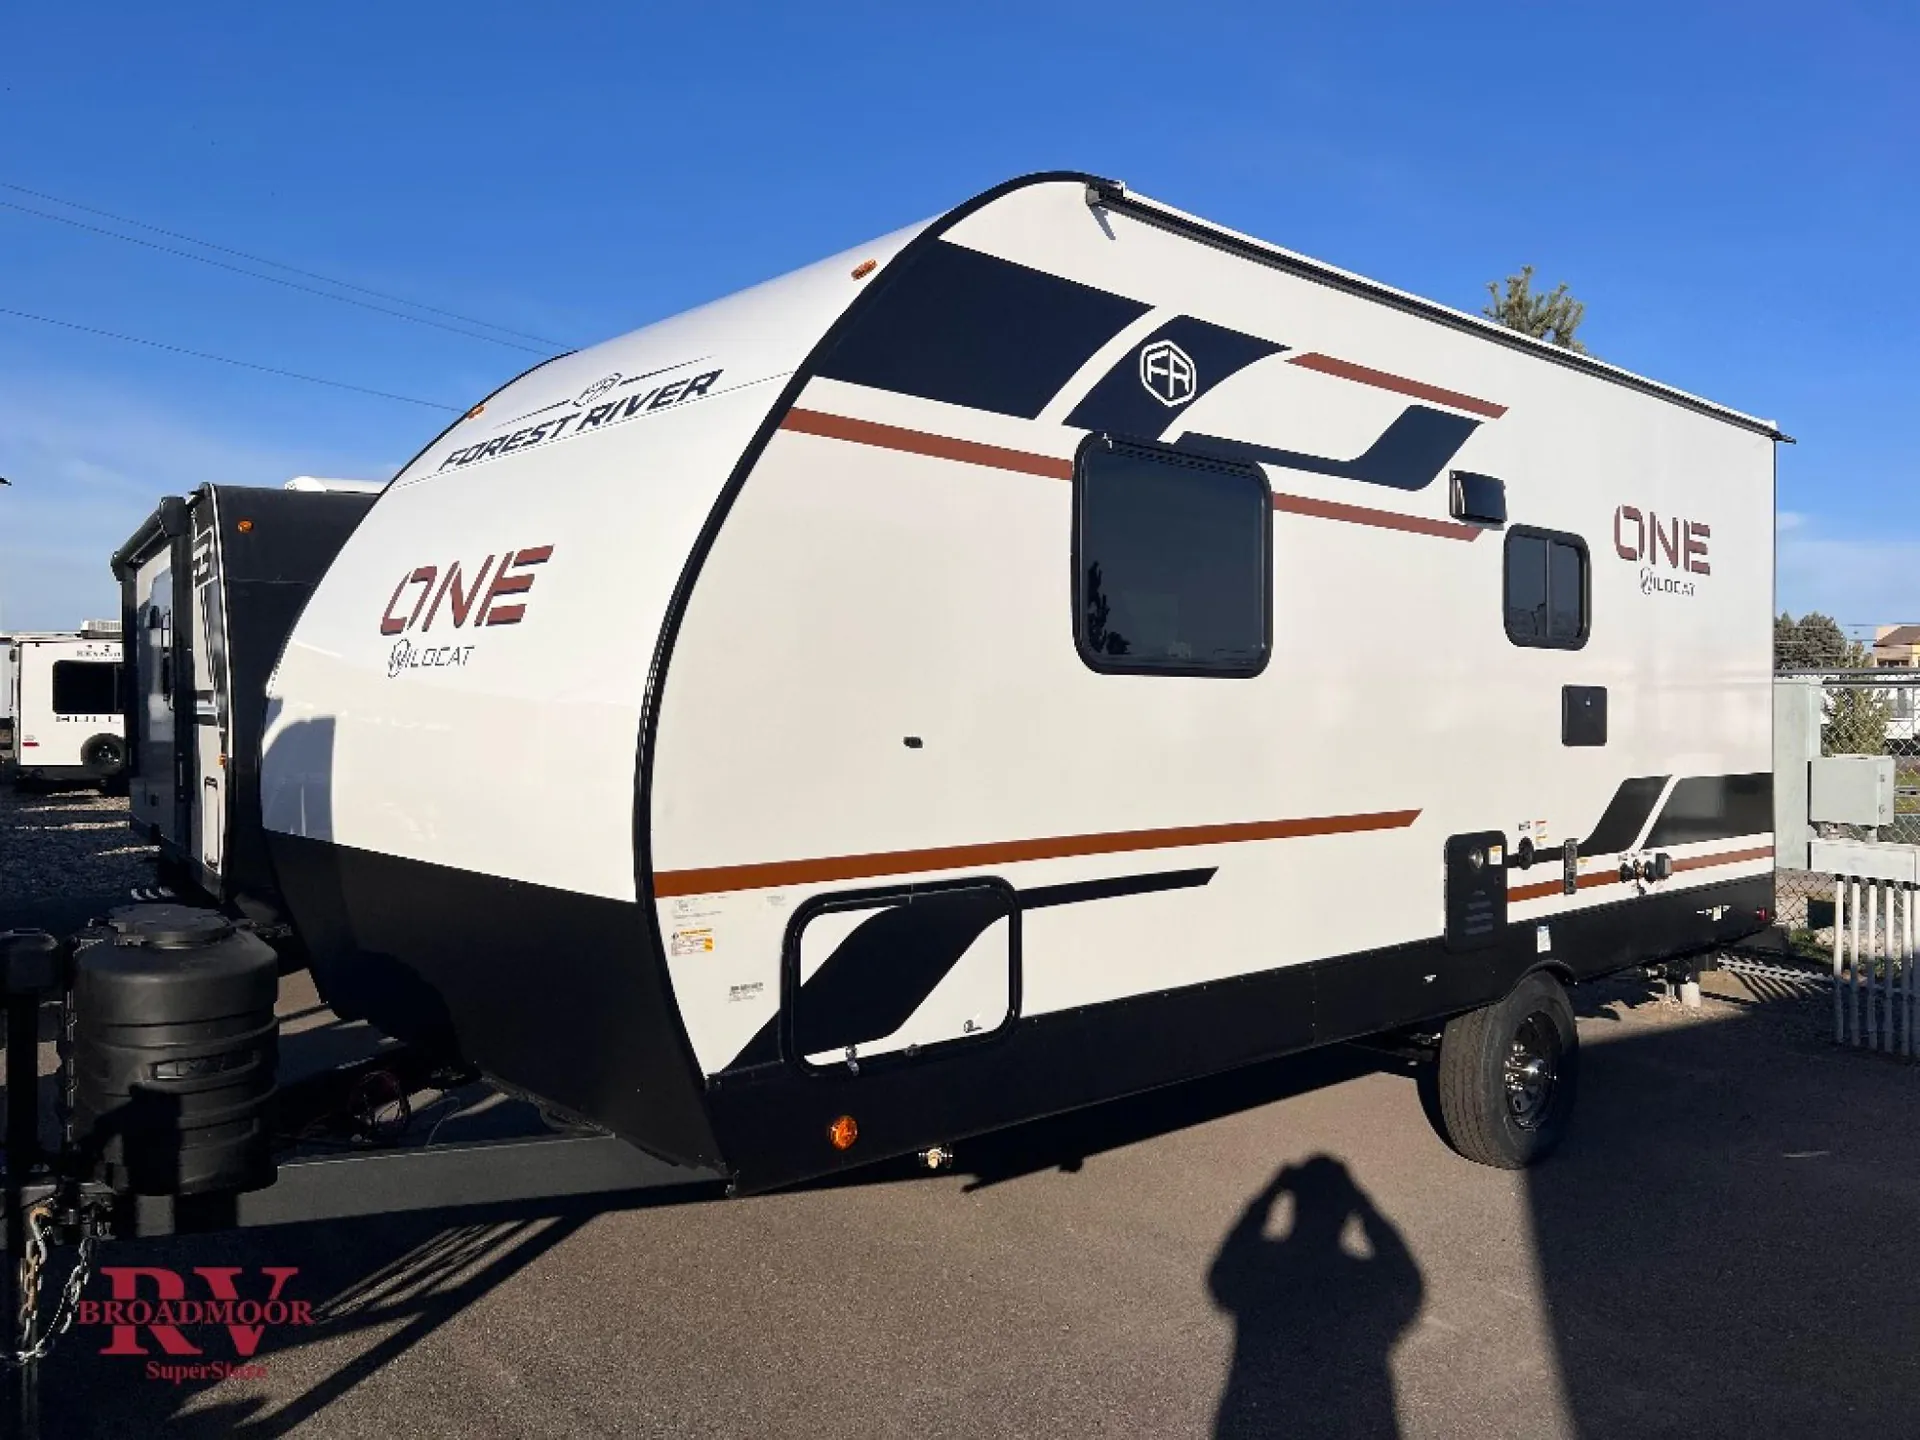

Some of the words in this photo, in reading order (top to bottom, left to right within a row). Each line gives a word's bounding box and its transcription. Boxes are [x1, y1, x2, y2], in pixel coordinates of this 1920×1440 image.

[437, 411, 582, 472] FOREST
[576, 369, 725, 432] RIVER
[1614, 504, 1711, 576] ONE
[380, 544, 555, 635] ONE
